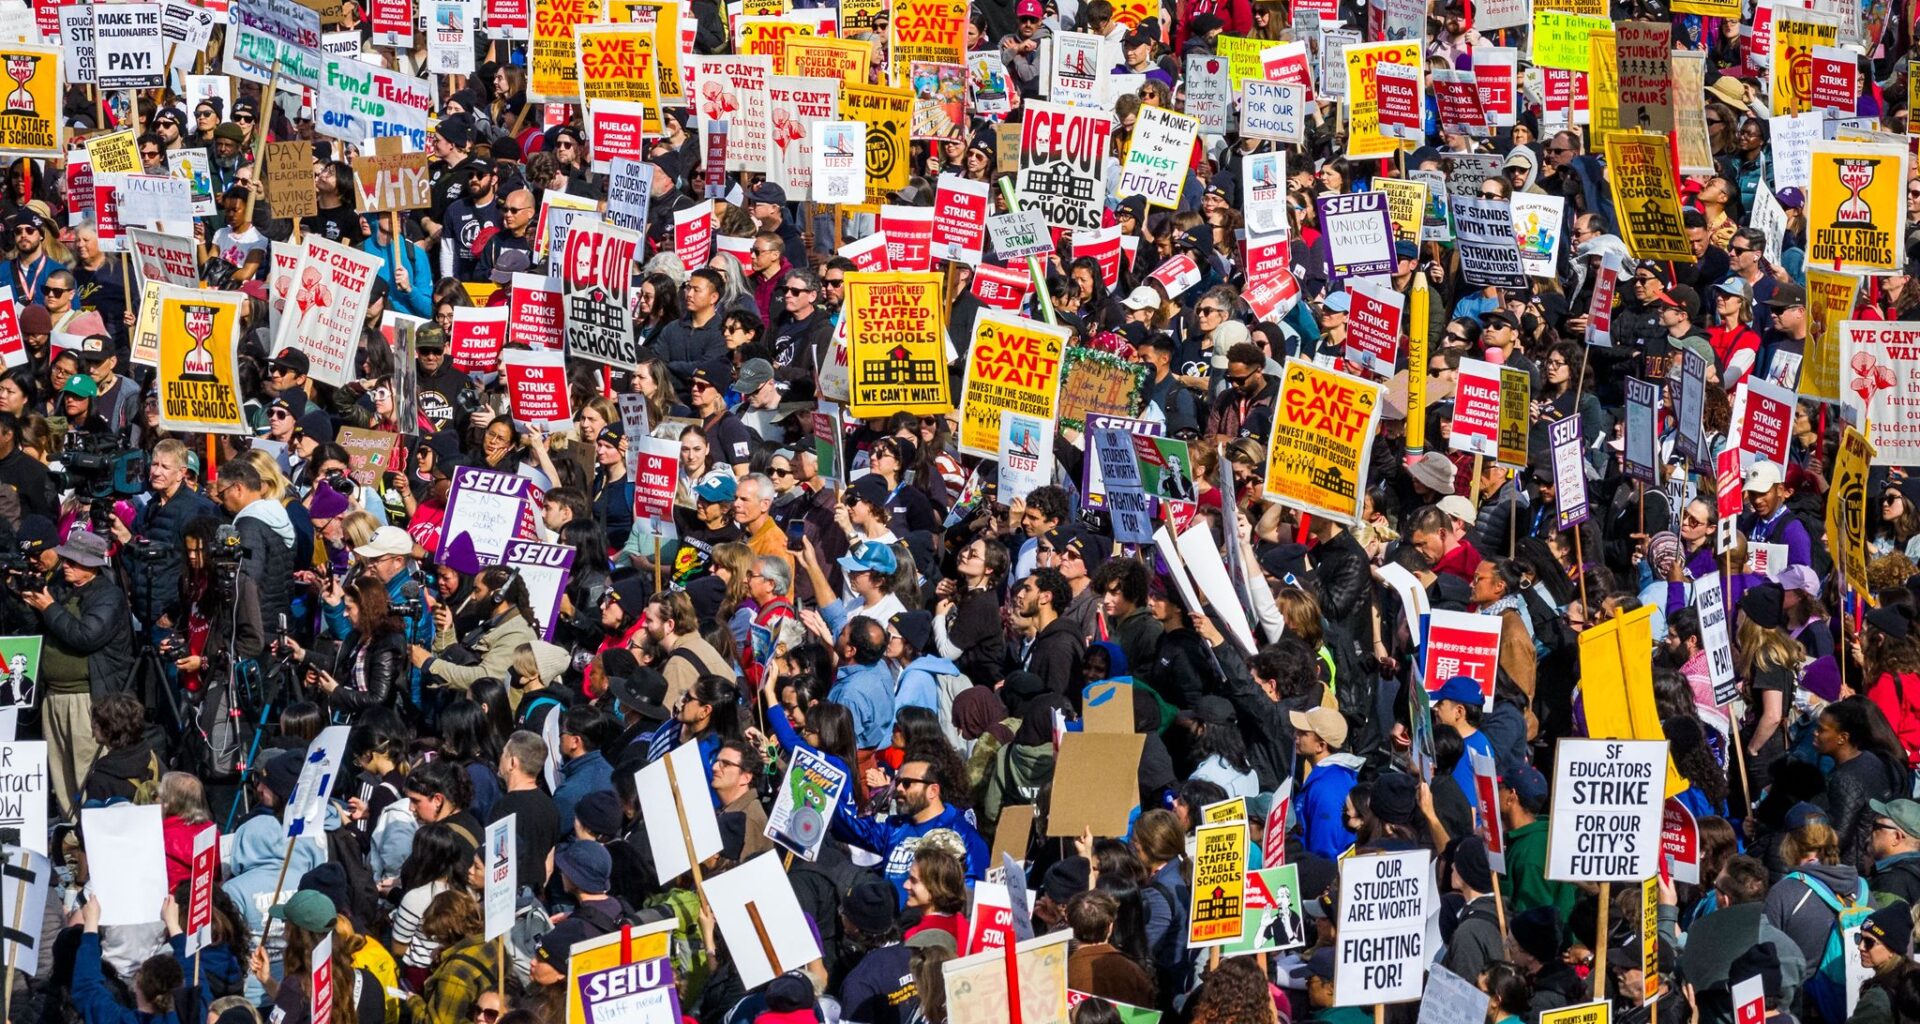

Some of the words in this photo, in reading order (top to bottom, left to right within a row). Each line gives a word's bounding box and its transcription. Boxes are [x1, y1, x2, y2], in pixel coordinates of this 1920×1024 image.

[98, 13, 131, 26] MAKE
[135, 11, 157, 24] THE
[99, 27, 158, 38] BILLIONAIRES
[439, 33, 464, 43] UESF
[322, 40, 357, 53] STANDS
[598, 40, 634, 52] WE
[108, 52, 151, 71] PAY!
[1827, 64, 1840, 73] ON
[327, 62, 371, 94] Fund
[585, 66, 646, 79] WAIT
[703, 63, 722, 74] WE
[726, 64, 764, 78] CAN'T
[732, 78, 764, 90] WAIT
[1820, 74, 1847, 86] STRIKE
[1249, 84, 1290, 98] STAND
[1381, 83, 1413, 96] HUELGA
[351, 98, 385, 117] FUND
[750, 96, 765, 106] for
[1831, 96, 1853, 104] SCHOOLS
[748, 108, 765, 117] the
[1248, 101, 1266, 112] FOR
[1273, 104, 1292, 116] OUR
[600, 121, 636, 132] HUELGA
[732, 117, 766, 127] future
[1144, 109, 1156, 122] The
[1159, 113, 1195, 132] MONEY
[1248, 117, 1294, 133] SCHOOLS
[268, 144, 305, 161] PAY
[1021, 109, 1064, 168] ICE
[1066, 116, 1110, 181] OUT
[626, 164, 640, 176] OUR
[825, 158, 853, 167] UESF
[1847, 165, 1865, 173] WE
[268, 172, 313, 180] TEACHERS
[355, 167, 430, 211] WHY?
[615, 176, 646, 193] STUDENTS
[1121, 172, 1178, 201] FUTURE
[270, 191, 313, 204] LIVING
[610, 188, 624, 200] ARE
[625, 192, 646, 207] WORTH
[953, 194, 968, 205] ON
[1039, 194, 1053, 202] OF
[1063, 198, 1087, 208] OUR
[1323, 195, 1378, 214] SEIU
[272, 204, 313, 217] WAGE
[944, 206, 975, 219] STRIKE
[1455, 205, 1466, 217] SF
[1469, 208, 1509, 221] STANDS
[1841, 209, 1868, 220] WAIT
[607, 211, 644, 232] FIGHTING
[999, 216, 1014, 225] THIS
[1018, 214, 1024, 222] IS
[1331, 217, 1378, 232] UNIONS
[994, 226, 1011, 236] THE
[1014, 223, 1036, 233] LAST
[1458, 220, 1484, 233] WITH
[1488, 223, 1512, 237] THE
[1006, 236, 1038, 248] STRAW!
[1336, 234, 1383, 245] UNITED
[1817, 229, 1851, 245] FULLY
[1855, 230, 1889, 247] STAFF
[1462, 245, 1518, 260] STRIKING
[1813, 244, 1837, 260] OUR
[1840, 247, 1891, 263] SCHOOLS
[564, 229, 603, 294] ICE
[602, 239, 636, 309] OUT
[1352, 265, 1374, 273] LOCAL
[1465, 258, 1518, 272] EDUCATORS!
[868, 286, 899, 296] STUDENTS
[907, 286, 925, 295] NEED
[870, 296, 921, 307] FULLY
[858, 309, 934, 320] STAFFED,
[582, 324, 594, 332] OF
[601, 329, 622, 339] OUR
[863, 321, 924, 331] STABLE
[859, 332, 936, 343] SCHOOLS
[570, 329, 636, 363] SCHOOLS
[1409, 337, 1421, 384] STRIKE
[525, 368, 543, 379] ON
[169, 382, 198, 398] FULLY
[202, 384, 230, 401] STAFF
[518, 382, 555, 392] STRIKE
[862, 389, 878, 401] WE
[881, 389, 909, 401] CAN'T
[912, 387, 939, 401] WAIT!
[1311, 378, 1355, 399] WE
[1408, 389, 1418, 410] ON
[167, 399, 189, 416] OUR
[191, 401, 236, 419] SCHOOLS
[1287, 405, 1359, 442] WAIT
[1278, 424, 1303, 440] INVEST
[1329, 440, 1356, 459] SCHOOLS
[1277, 435, 1292, 446] OUR
[1294, 438, 1328, 458] STUDENTS
[1329, 449, 1356, 471] DESERVE
[459, 471, 524, 495] SEIU
[508, 542, 568, 565] SEIU
[1436, 657, 1485, 682] 罷工
[1607, 745, 1622, 759] SF
[1570, 762, 1651, 778] EDUCATORS
[1573, 782, 1649, 805] STRIKE
[1576, 816, 1604, 831] FOR
[1610, 815, 1640, 832] OUR
[1206, 842, 1234, 853] FULLY
[1578, 834, 1635, 853] CITY'S
[1198, 852, 1242, 866] STAFFED,
[1571, 856, 1639, 875] FUTURE
[493, 867, 508, 883] UESF
[1200, 864, 1235, 875] STABLE
[1377, 861, 1401, 878] OUR
[1197, 874, 1241, 886] SCHOOLS
[1354, 879, 1418, 901] STUDENTS
[1348, 903, 1375, 921] ARE
[1379, 899, 1421, 918] WORTH
[1344, 935, 1420, 964] FIGHTING
[589, 961, 660, 1001] SEIU
[1364, 964, 1402, 989] FOR!
